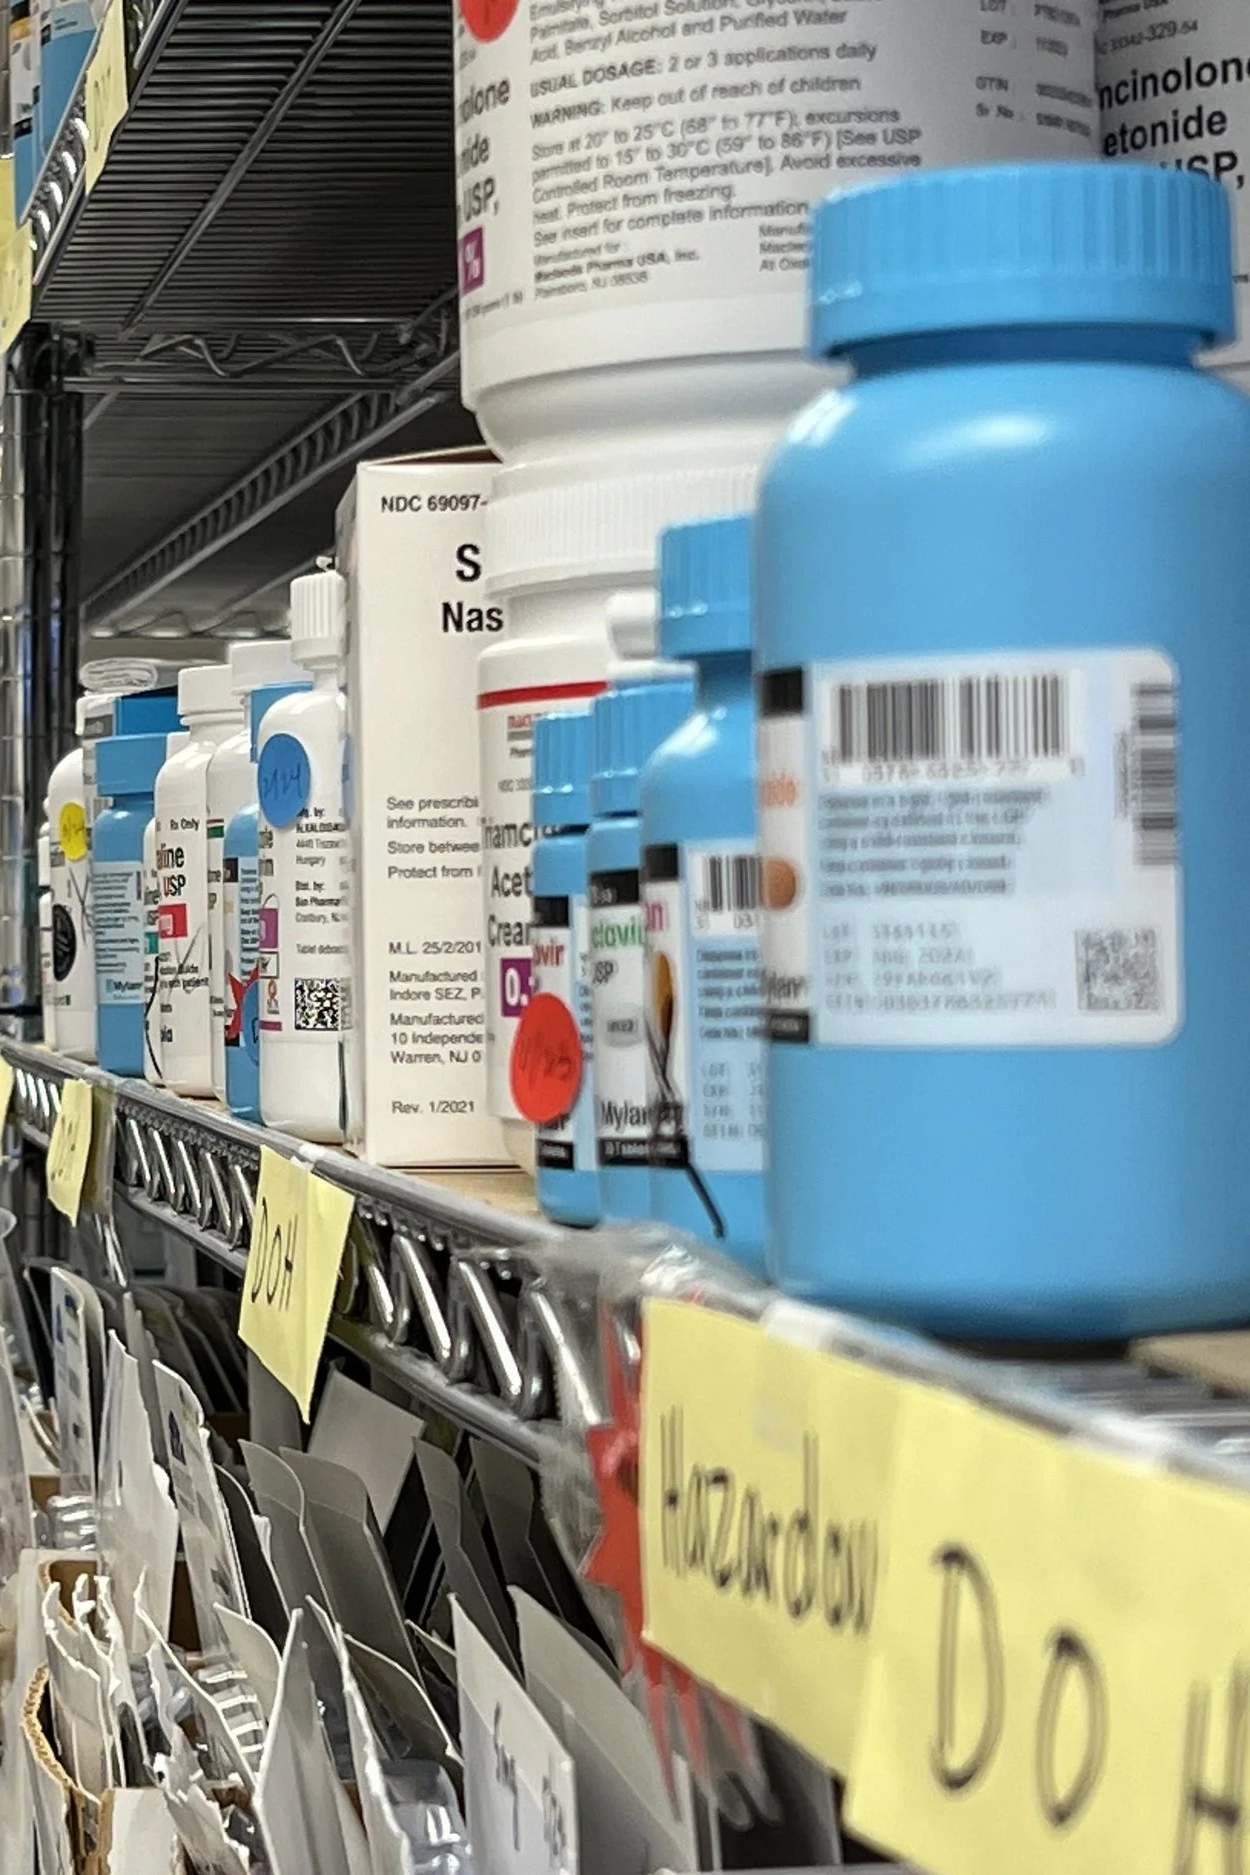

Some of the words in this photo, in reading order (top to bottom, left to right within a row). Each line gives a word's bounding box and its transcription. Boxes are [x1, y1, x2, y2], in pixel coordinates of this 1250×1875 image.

[615, 22, 676, 45] Alcohol
[682, 18, 713, 36] and
[720, 11, 788, 31] Purified
[793, 10, 847, 26] Water
[582, 58, 662, 86] DOSAGE:
[668, 56, 680, 73] 2
[684, 55, 701, 70] or
[707, 51, 718, 67] 3
[724, 46, 830, 67] applications
[835, 43, 878, 62] daily
[1099, 55, 1250, 112] ncinolon
[530, 100, 605, 129] WARNING:
[611, 94, 653, 112] Keep
[657, 88, 685, 106] out
[689, 84, 707, 102] of
[711, 80, 762, 99] reach
[767, 77, 786, 95] of
[789, 75, 862, 94] children
[614, 129, 629, 144] to
[805, 109, 901, 126] excursions
[596, 154, 609, 169] to
[646, 145, 661, 161] to
[758, 134, 775, 151] to
[882, 128, 922, 146] USP
[603, 171, 649, 190] Room
[780, 153, 831, 171] Avoid
[836, 153, 922, 168] excessive
[1161, 150, 1244, 189] SP,
[567, 196, 618, 218] Protect
[622, 190, 657, 209] from
[603, 217, 623, 235] for
[627, 210, 704, 231] complete
[709, 200, 808, 221] information
[381, 495, 422, 512] NDC
[427, 494, 488, 512] 69097-
[455, 543, 482, 582] S
[441, 601, 504, 633] Nas
[387, 796, 414, 811] See
[181, 818, 199, 832] Only
[387, 816, 467, 829] information.
[387, 840, 425, 854] Store
[388, 866, 437, 879] Protect
[441, 865, 473, 878] from
[389, 970, 478, 983] Manufactured
[389, 988, 431, 1001] Indore
[391, 1032, 407, 1045] 10
[391, 1051, 445, 1066] Warren,
[449, 1051, 468, 1063] NJ
[392, 1101, 424, 1114] Rev.
[429, 1101, 474, 1114] 1/2021
[658, 1403, 880, 1640] Hazardou
